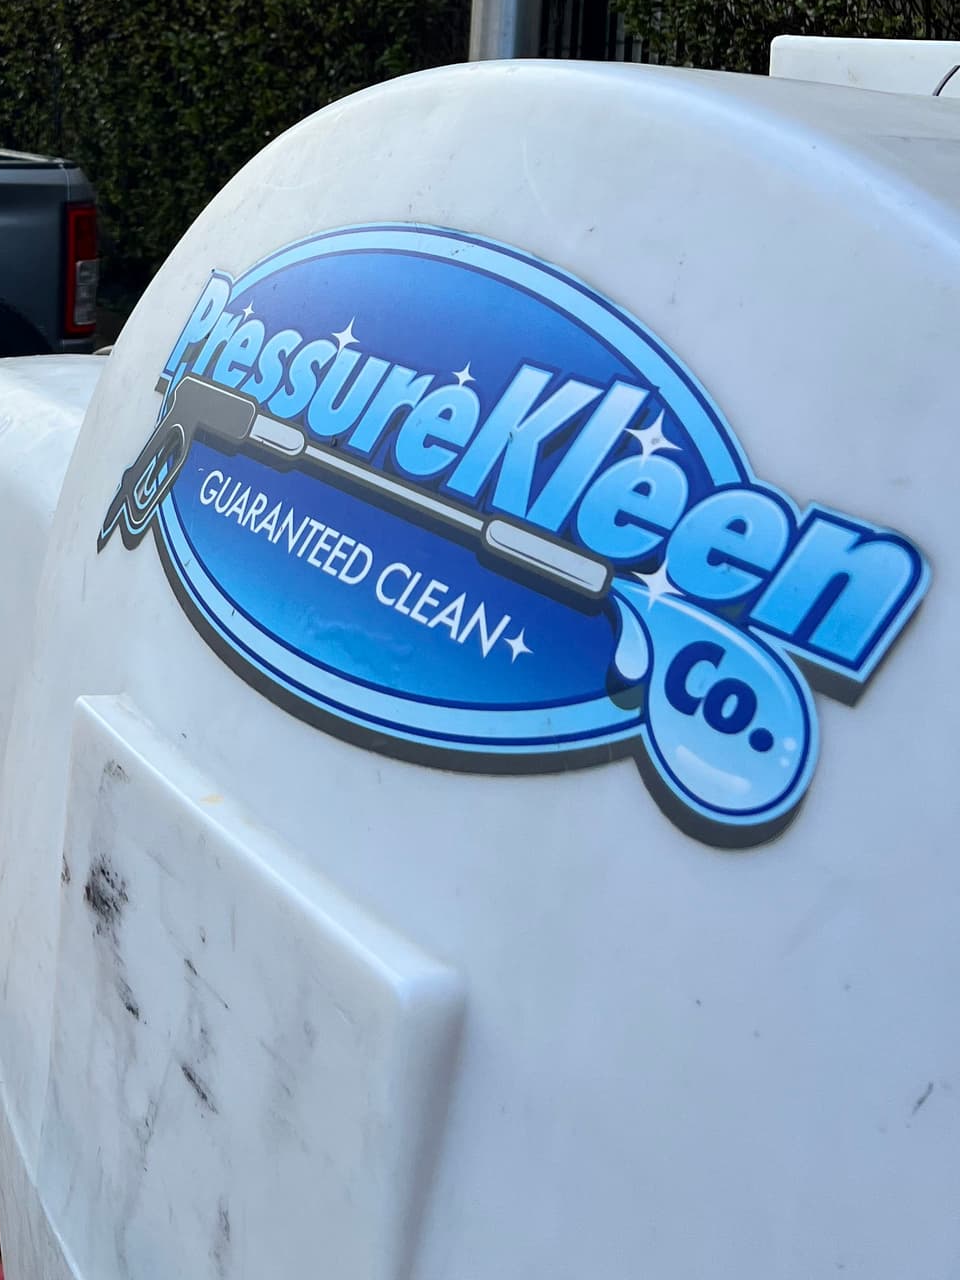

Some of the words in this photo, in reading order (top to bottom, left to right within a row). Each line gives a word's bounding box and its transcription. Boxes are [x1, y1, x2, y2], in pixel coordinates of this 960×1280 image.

[168, 274, 920, 667] PressureKleen
[199, 468, 374, 586] GUARANTEED
[374, 563, 512, 660] CLEAN
[661, 640, 775, 754] Co.
